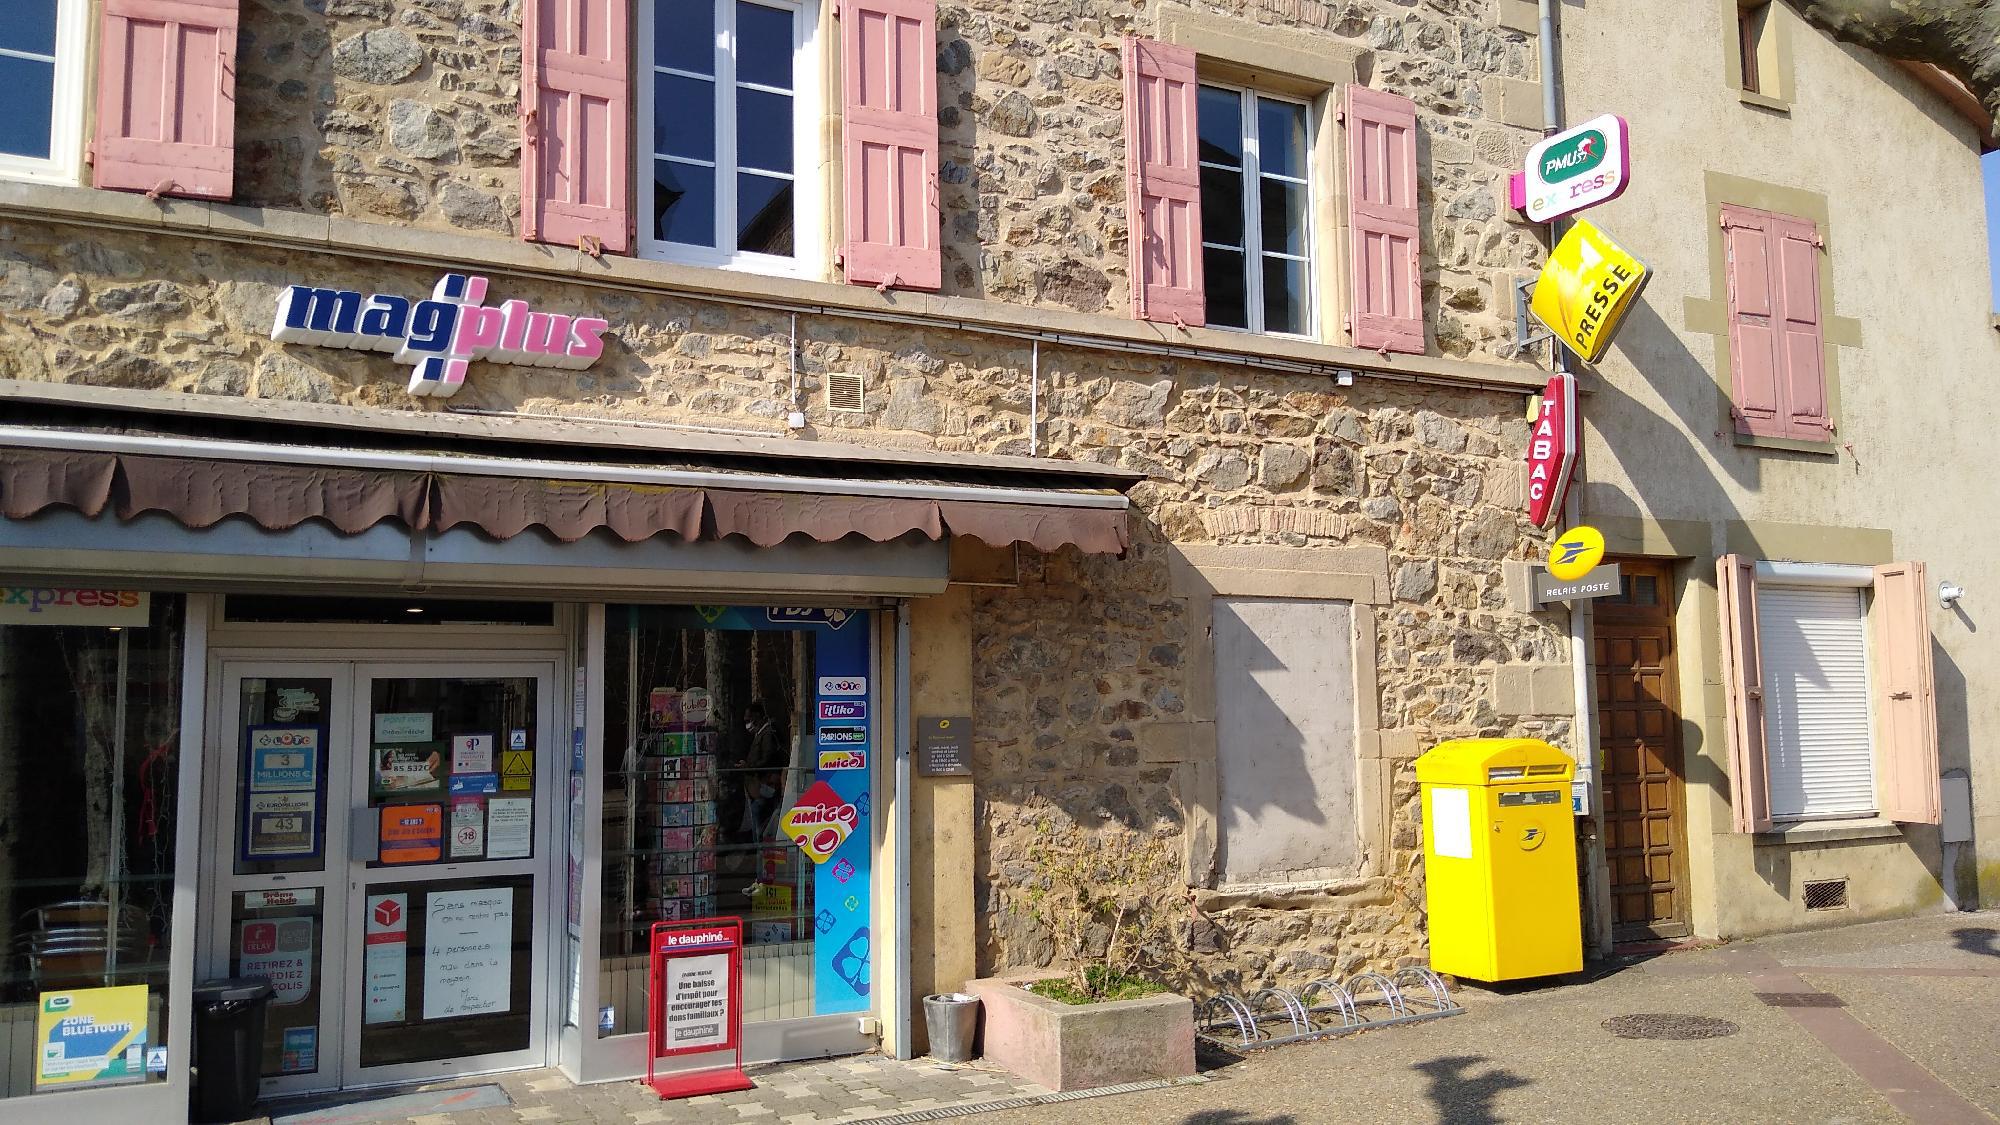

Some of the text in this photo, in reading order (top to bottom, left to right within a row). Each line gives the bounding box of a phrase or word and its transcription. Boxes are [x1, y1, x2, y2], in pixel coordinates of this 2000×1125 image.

[1545, 152, 1577, 176] PMU
[1533, 168, 1616, 212] exress
[1575, 264, 1632, 350] PRESSE
[1529, 400, 1554, 501] TABAC
[1546, 582, 1609, 597] RELAIS POSTE
[0, 587, 140, 613] xpress
[834, 680, 862, 691] LOTO
[820, 732, 853, 742] PARIONS
[280, 754, 290, 766] 3
[822, 756, 861, 769] AMIGO
[257, 770, 301, 778] MILLIONS
[791, 803, 857, 825] AMIGO
[275, 818, 293, 830] 43
[459, 831, 475, 841] -18
[668, 931, 724, 946] le dauphiné
[431, 945, 440, 956] 4
[247, 959, 303, 970] RETIREZ &
[678, 978, 716, 990] Une baisse
[675, 989, 718, 1001] d'impôt pour
[671, 1000, 711, 1012] encourager
[62, 1016, 95, 1026] ZONE
[669, 1008, 725, 1022] dons familiaux ?
[62, 1022, 133, 1037] BLUETOOTH
[675, 1028, 682, 1038] le
